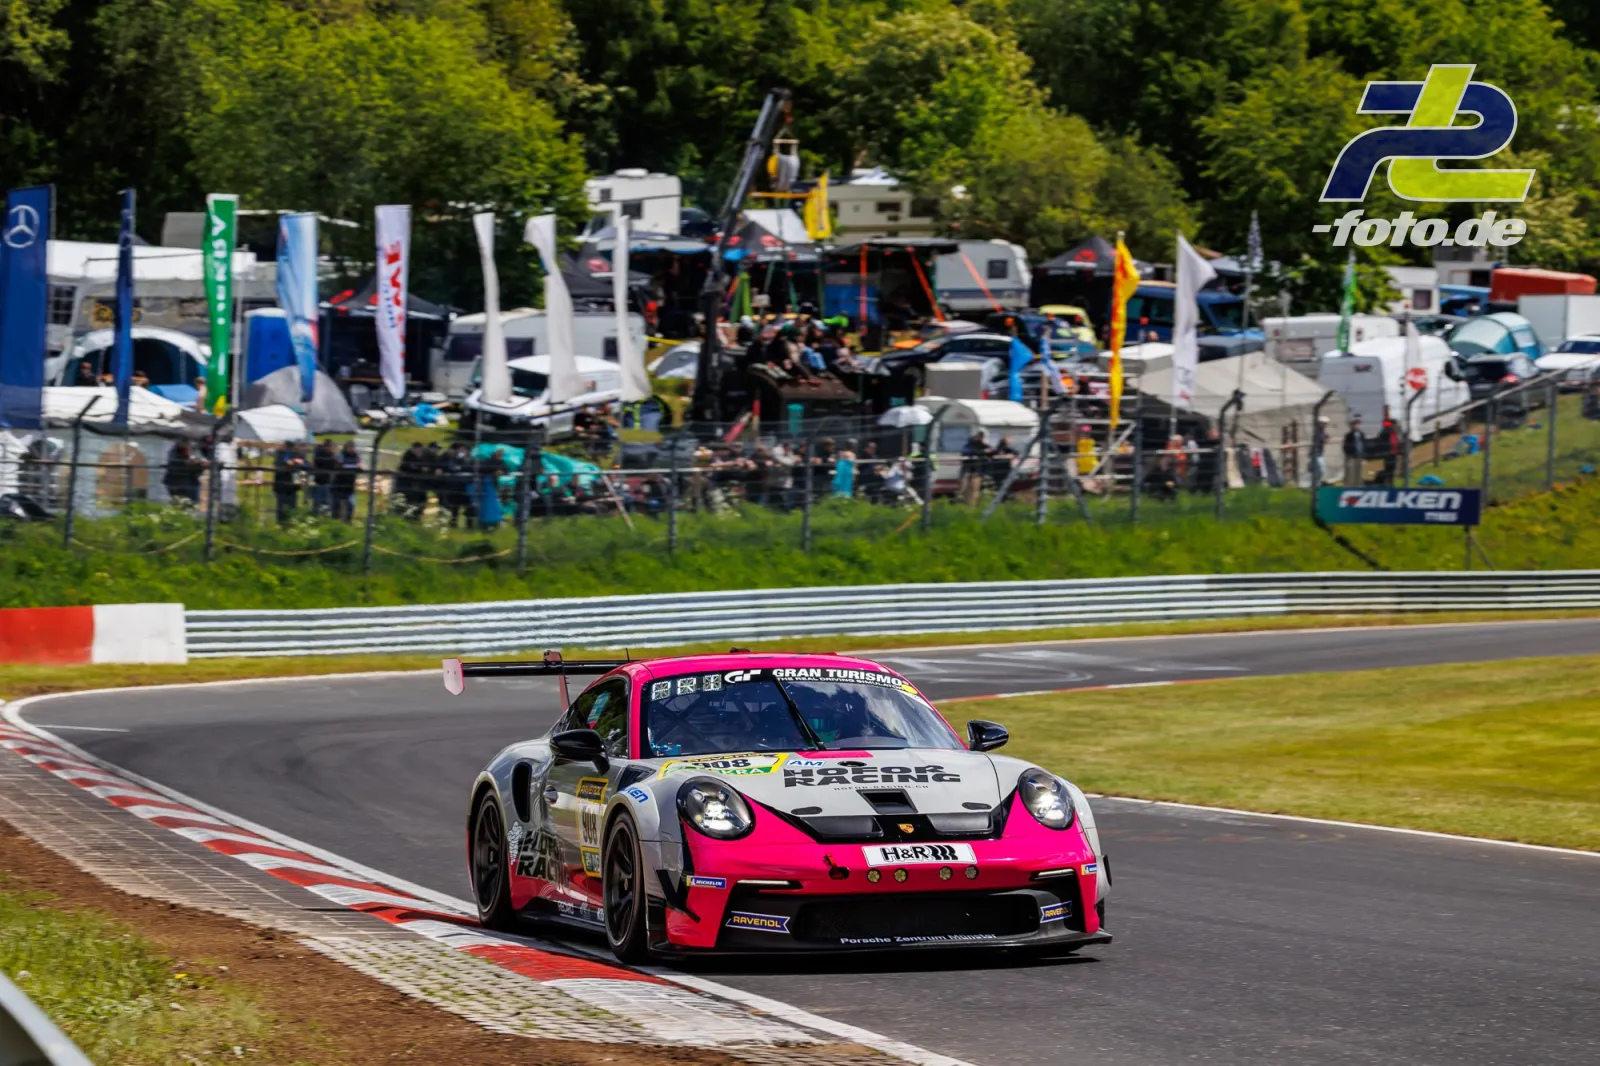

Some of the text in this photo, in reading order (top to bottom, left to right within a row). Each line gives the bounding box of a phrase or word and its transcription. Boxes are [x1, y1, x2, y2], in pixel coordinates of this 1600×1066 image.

[1339, 490, 1462, 510] FALKEN
[772, 668, 903, 687] GRAN TURISMO
[783, 765, 946, 777] HOFOR
[784, 773, 961, 788] RACING
[733, 915, 782, 928] RAVENOL
[840, 936, 892, 944] Porsche
[894, 935, 947, 943] Zentrum
